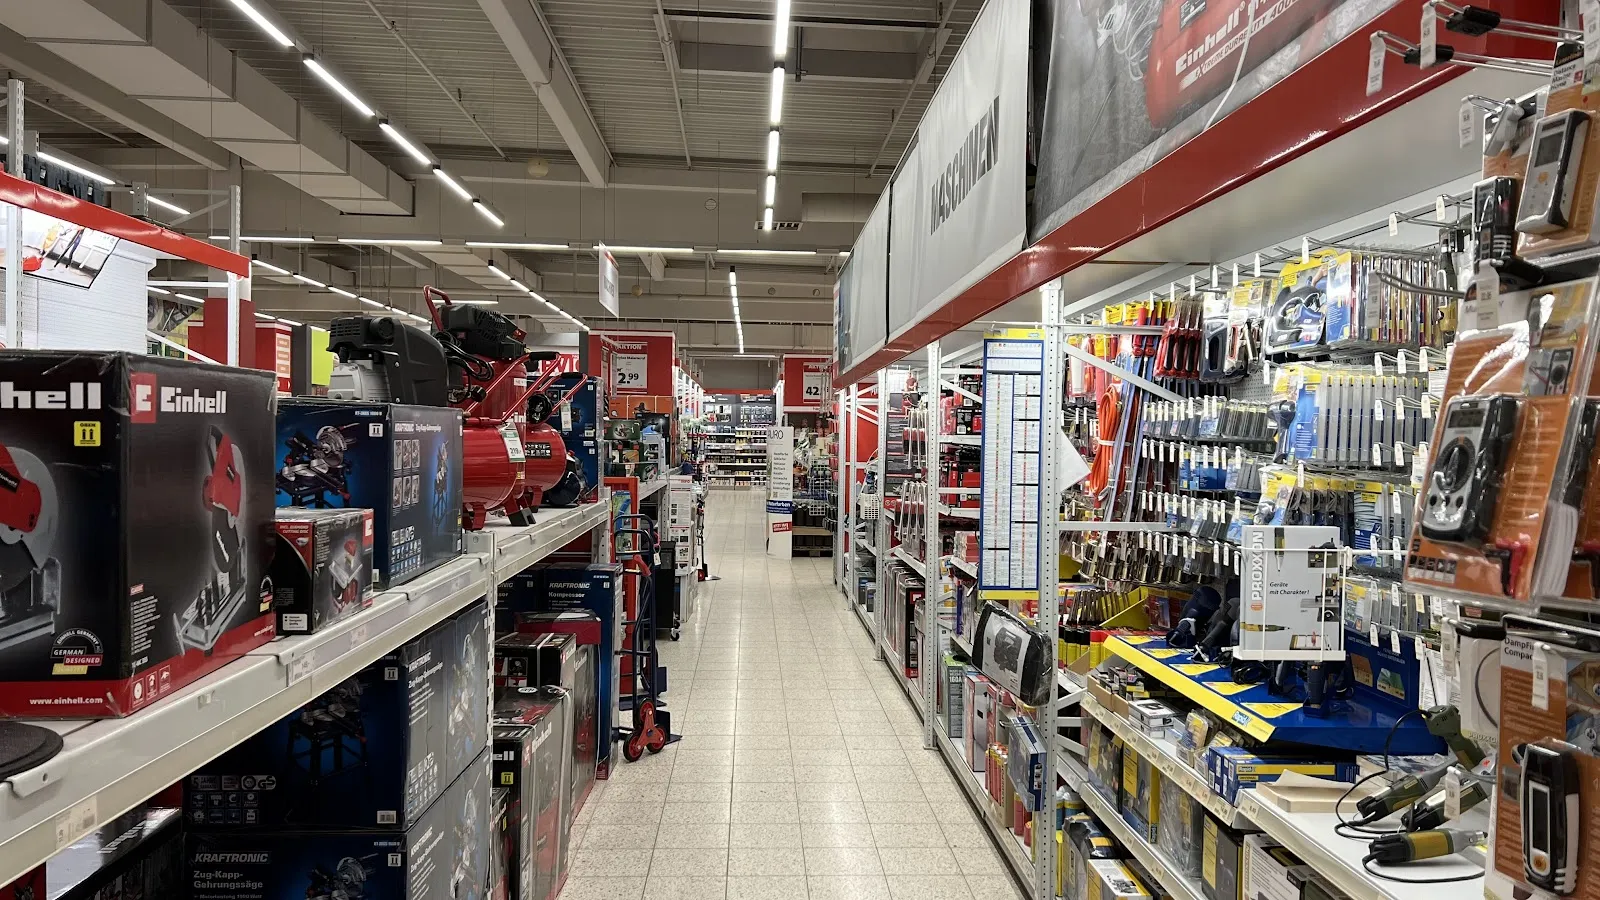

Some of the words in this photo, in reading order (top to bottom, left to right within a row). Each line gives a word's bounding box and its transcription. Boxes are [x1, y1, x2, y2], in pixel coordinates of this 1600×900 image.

[1175, 8, 1240, 76] Einhell
[931, 95, 1000, 236] MASCHINEN
[161, 386, 226, 413] Einhell
[1252, 531, 1264, 601] PROXXON
[65, 657, 101, 665] DESIGNED
[29, 696, 104, 705] www.einhell.com
[195, 853, 269, 863] KRAFTRONIC
[194, 870, 244, 879] Zug-Kapp-
